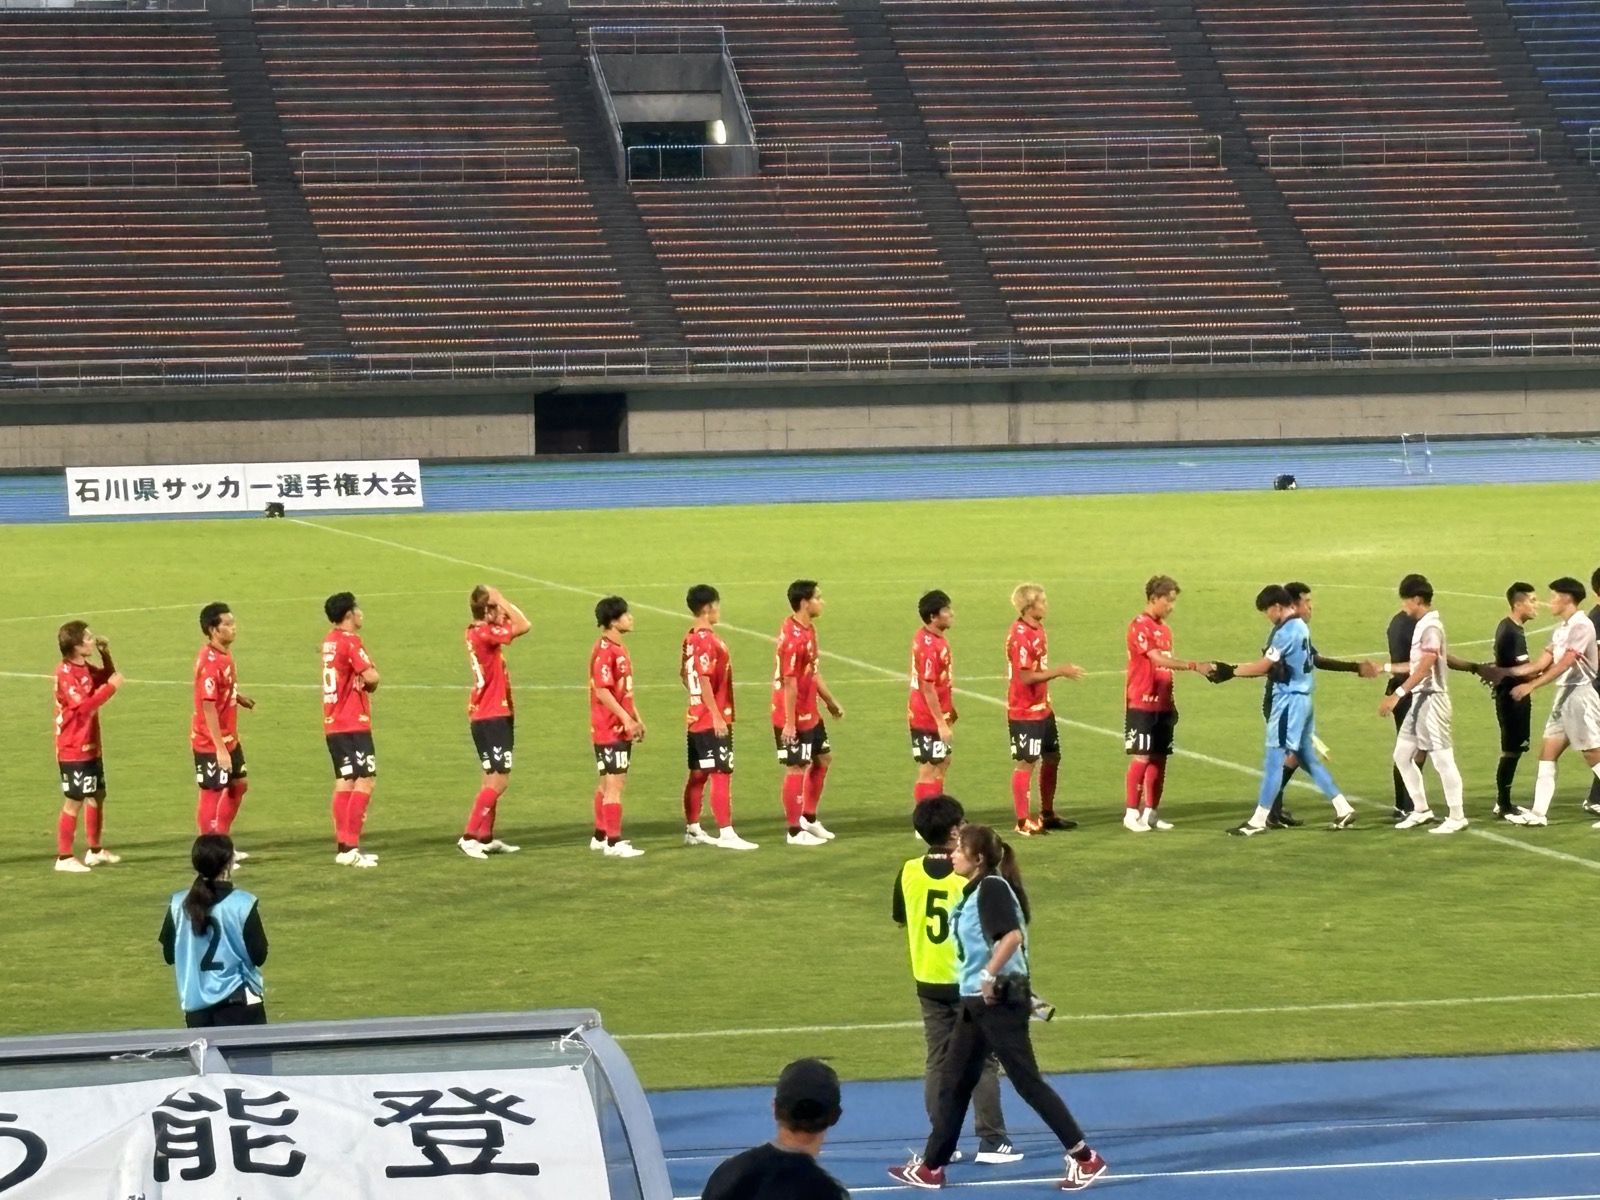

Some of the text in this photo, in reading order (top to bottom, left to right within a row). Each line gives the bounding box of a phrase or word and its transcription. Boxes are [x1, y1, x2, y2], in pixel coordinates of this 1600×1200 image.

[74, 471, 417, 502] 石川県サッカー選手権大会
[1138, 733, 1151, 751] 11
[926, 890, 950, 944] 5
[201, 915, 225, 972] 2
